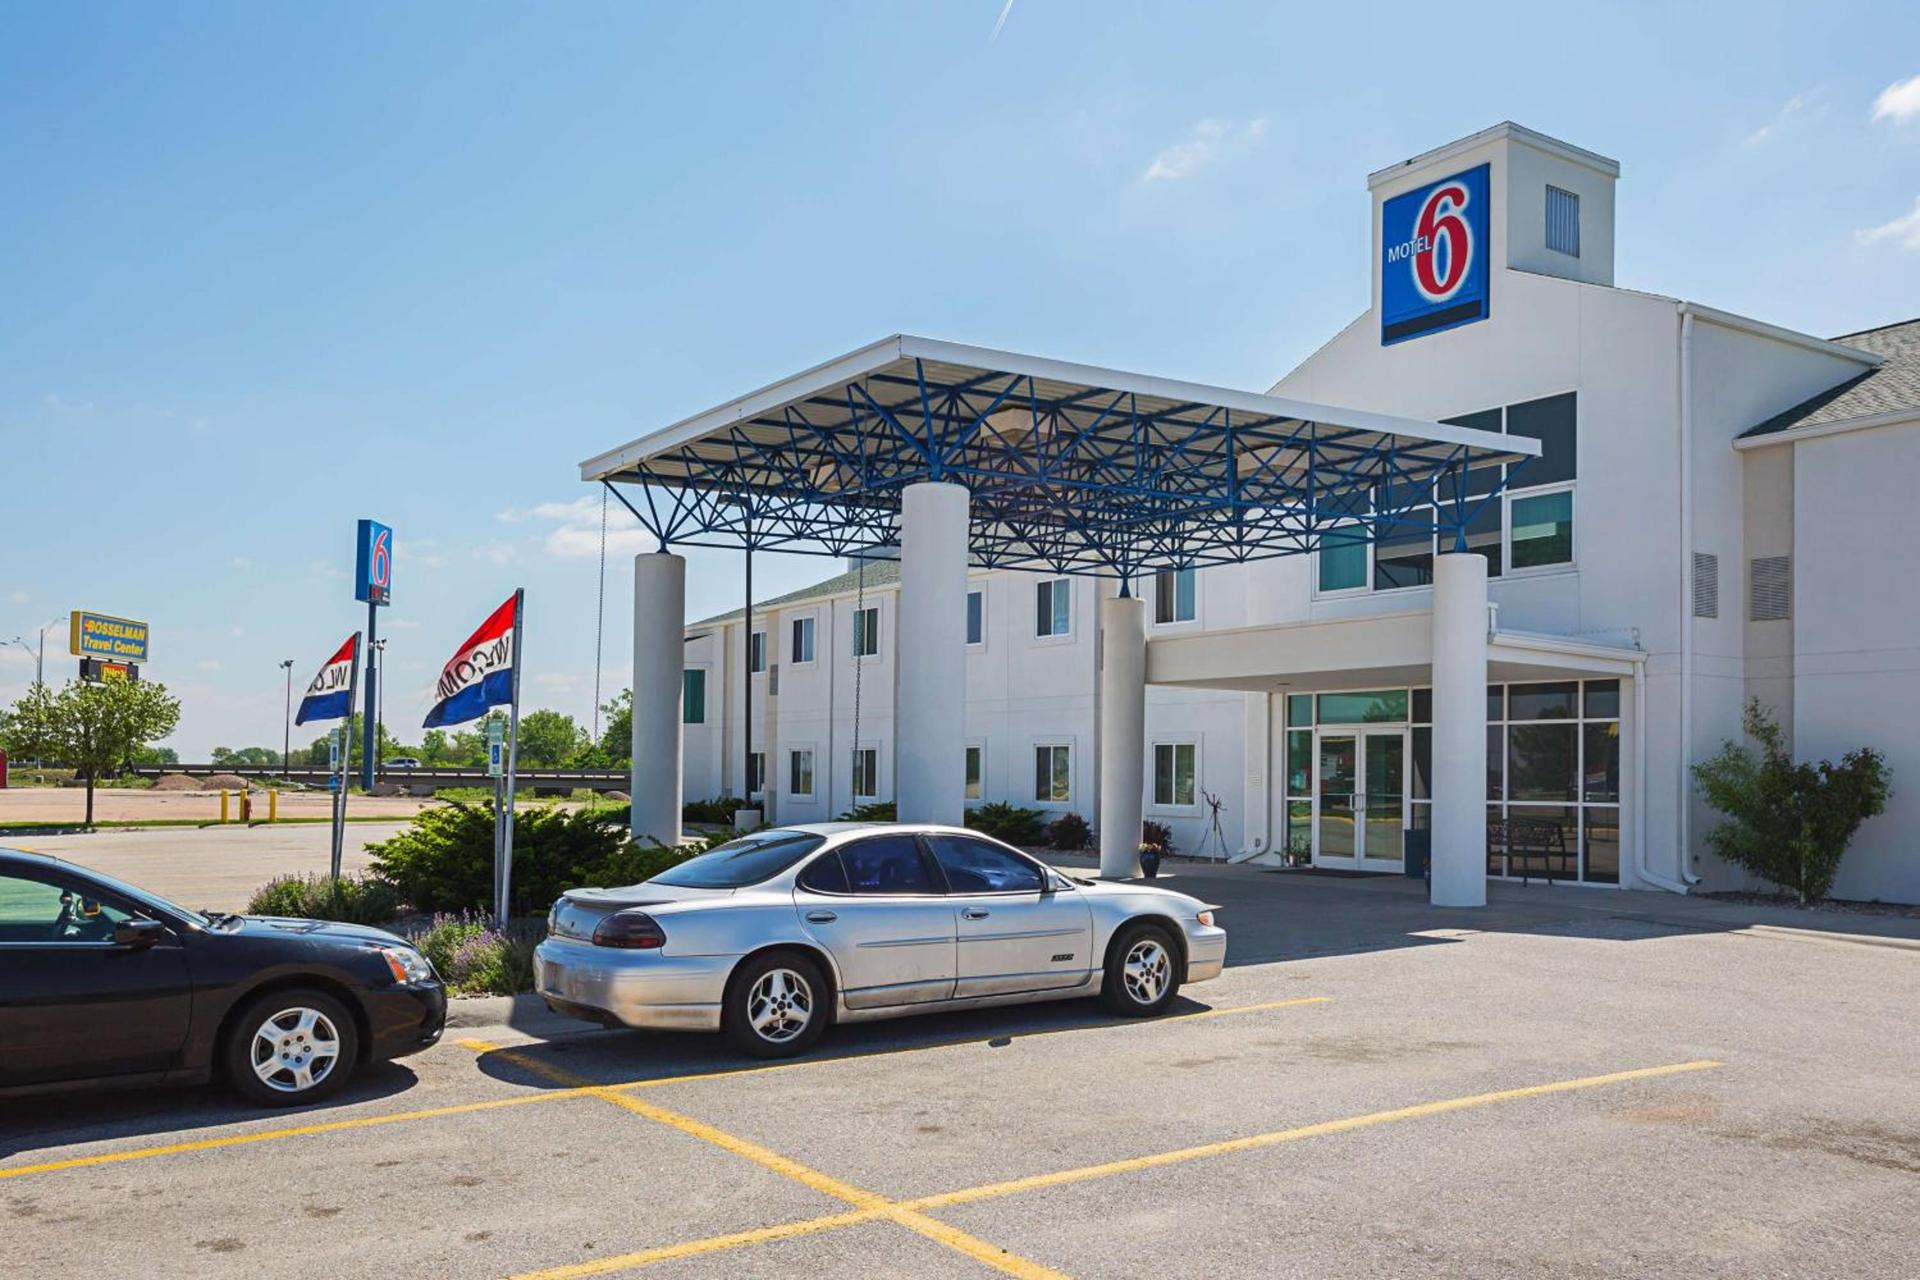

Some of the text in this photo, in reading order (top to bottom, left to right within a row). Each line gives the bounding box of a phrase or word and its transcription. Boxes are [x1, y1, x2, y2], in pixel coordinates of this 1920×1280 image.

[1388, 235, 1432, 264] MOTEL
[1412, 181, 1473, 302] 6
[372, 529, 390, 587] 6
[83, 634, 145, 655] Travel Center
[88, 620, 146, 641] BOSSELMAN
